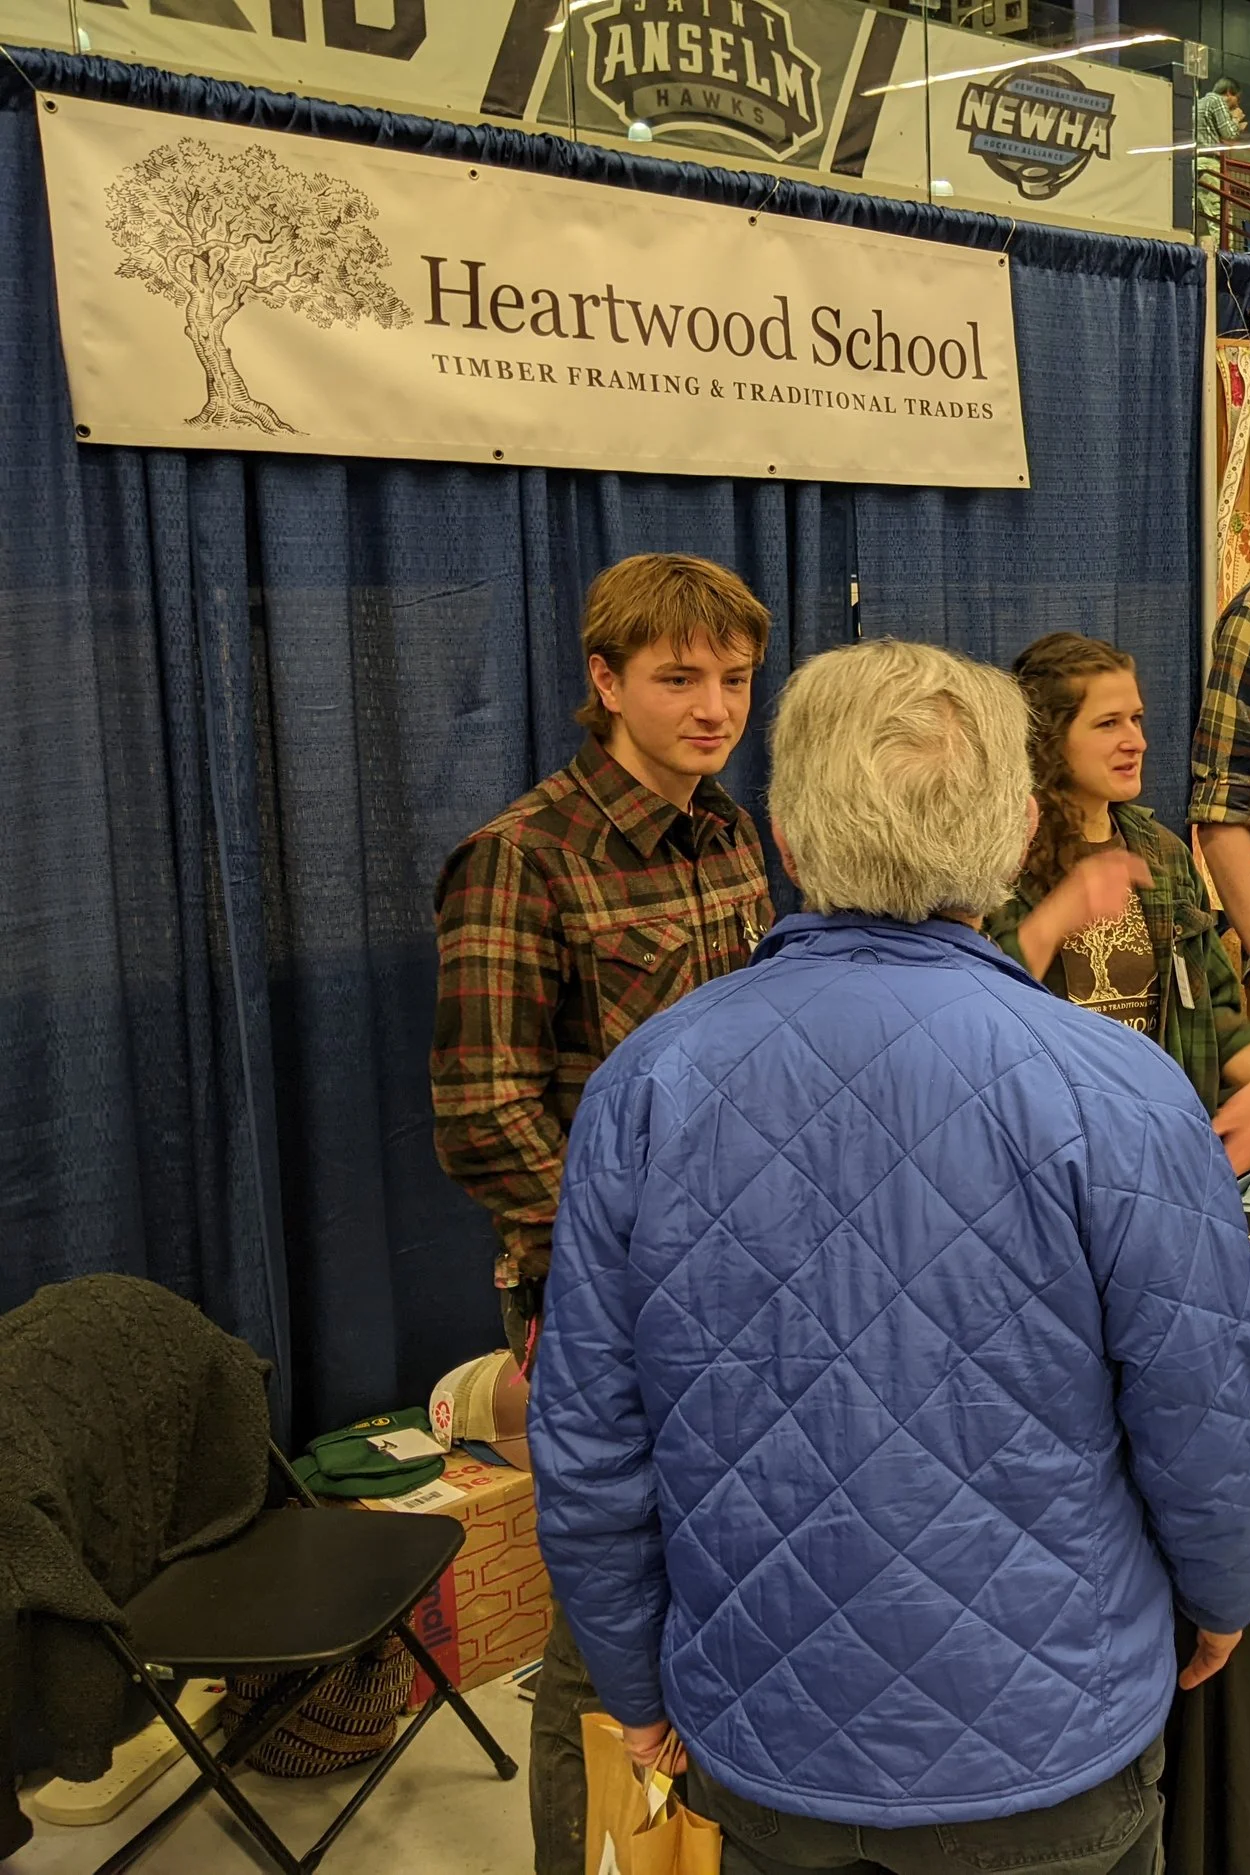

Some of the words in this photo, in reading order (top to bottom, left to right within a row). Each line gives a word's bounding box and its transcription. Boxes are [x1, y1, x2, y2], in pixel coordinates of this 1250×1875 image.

[601, 21, 811, 123] ANSELM
[656, 84, 766, 125] HAWKS
[1015, 82, 1033, 92] NEW
[961, 88, 1110, 155] NEWHA
[983, 139, 1019, 152] HOCKEY
[1021, 146, 1064, 161] ALLIANCE
[420, 254, 798, 361] Heartwood
[810, 305, 988, 380] School
[431, 353, 558, 384] TIMBER
[566, 366, 701, 396] FRAMING
[710, 379, 725, 398] &
[732, 381, 898, 414] TRADITIONAL
[903, 398, 994, 420] TRADES
